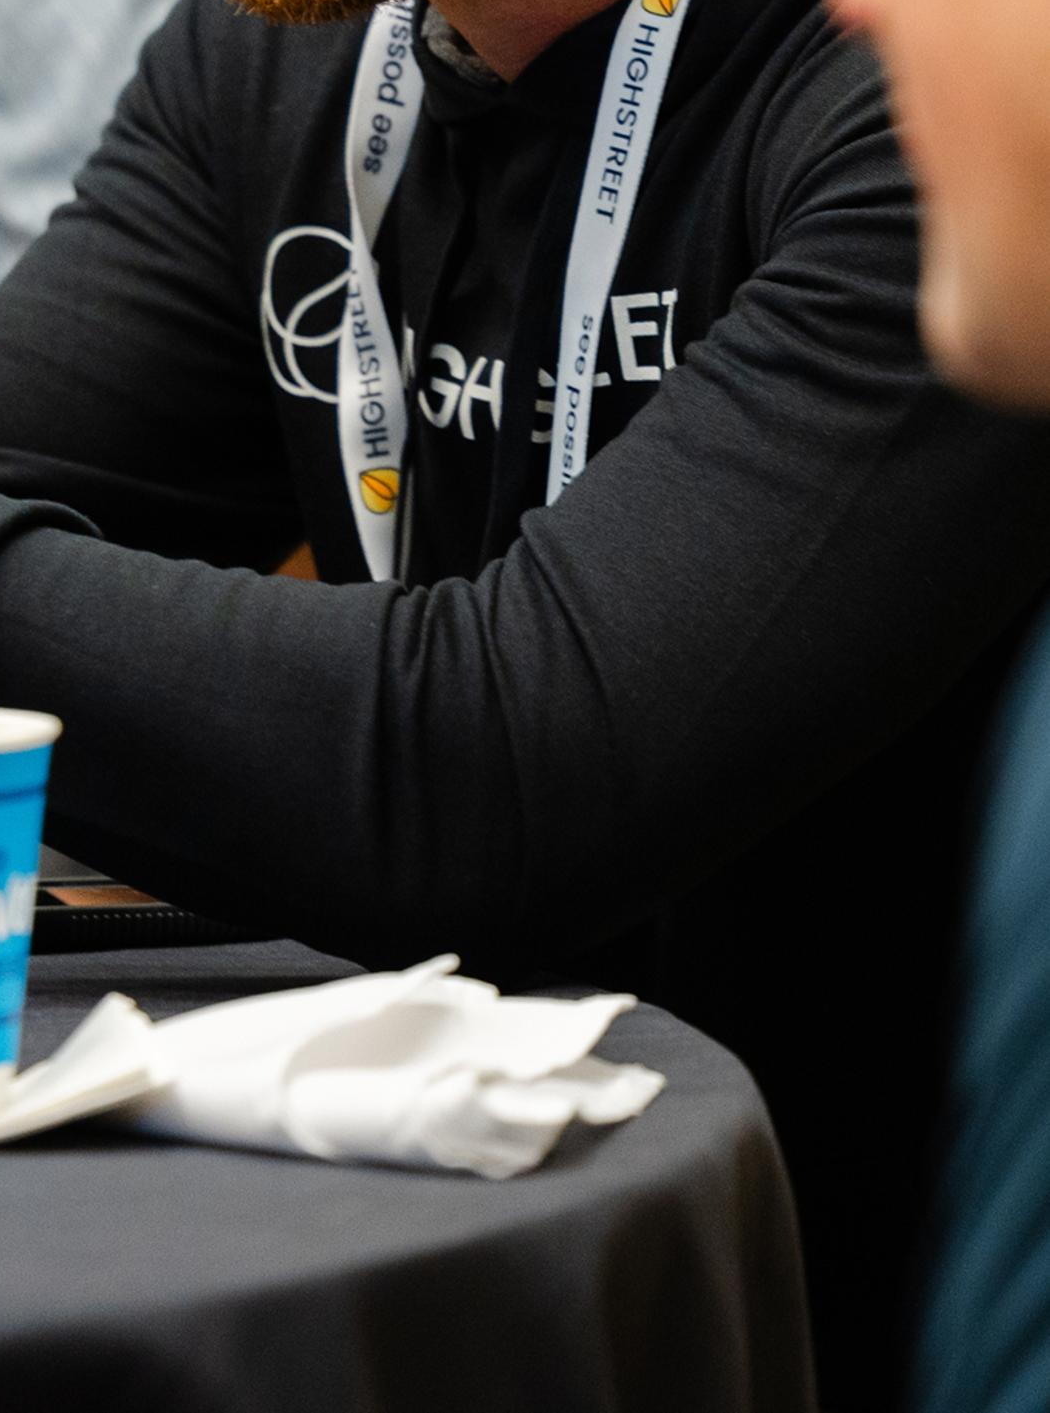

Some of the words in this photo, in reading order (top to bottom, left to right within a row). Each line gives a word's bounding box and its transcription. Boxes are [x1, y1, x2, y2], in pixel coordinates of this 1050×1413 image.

[363, 113, 392, 175] see
[596, 23, 659, 224] HIGHSTREET
[350, 268, 390, 459] HIGHSTREE
[575, 314, 594, 375] see
[561, 384, 580, 487] possi
